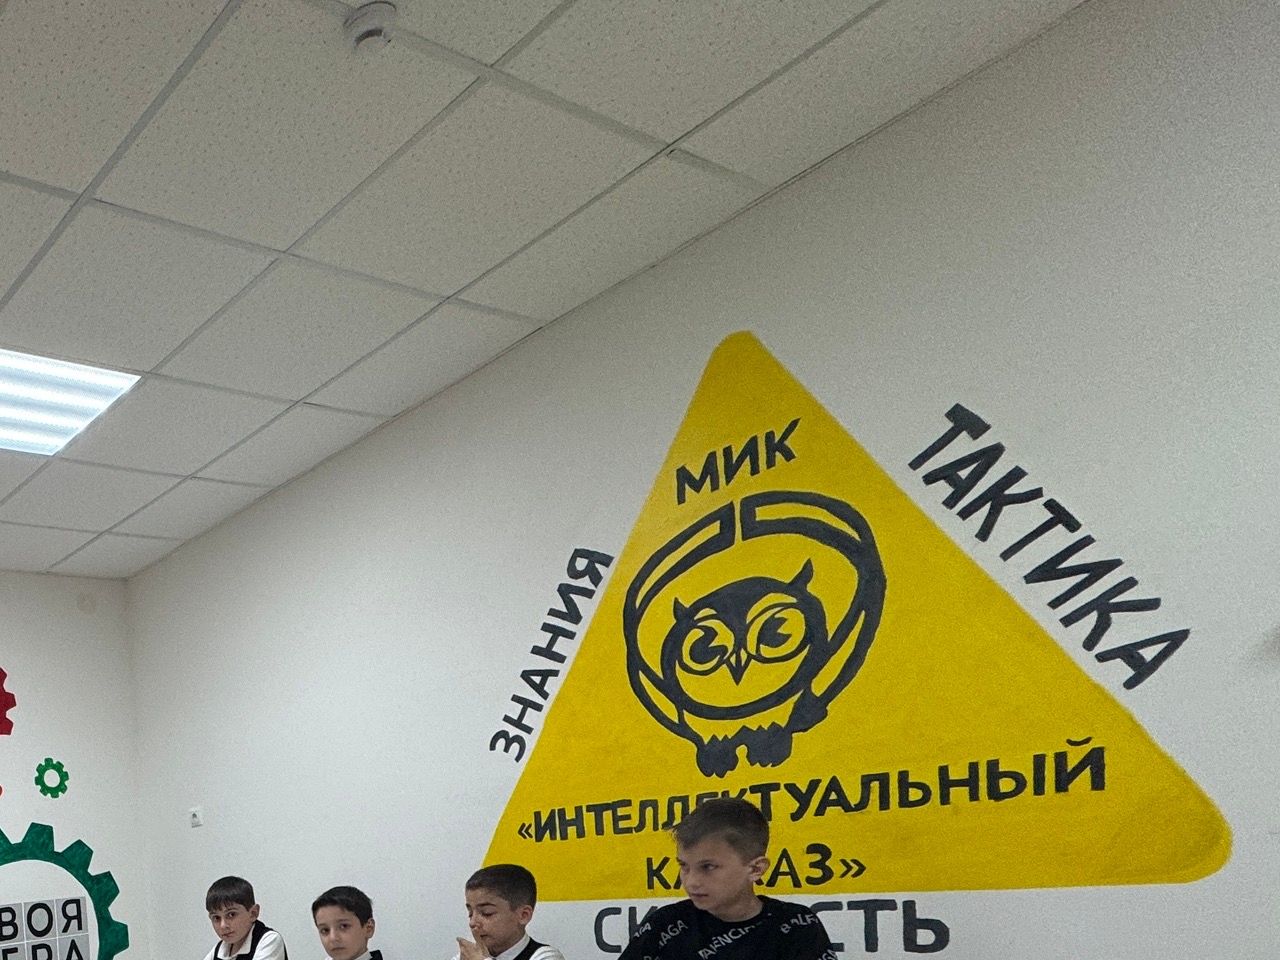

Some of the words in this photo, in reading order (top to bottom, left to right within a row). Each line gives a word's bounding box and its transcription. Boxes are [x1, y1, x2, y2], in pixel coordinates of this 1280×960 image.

[676, 417, 802, 505] МИК
[908, 403, 1190, 690] ТАКТИКА
[489, 548, 615, 763] ЗНАНИЯ
[518, 736, 1106, 842] «ИНТЕЛЛТУАЛЬНЫЙ
[646, 843, 867, 890] КАЗ»
